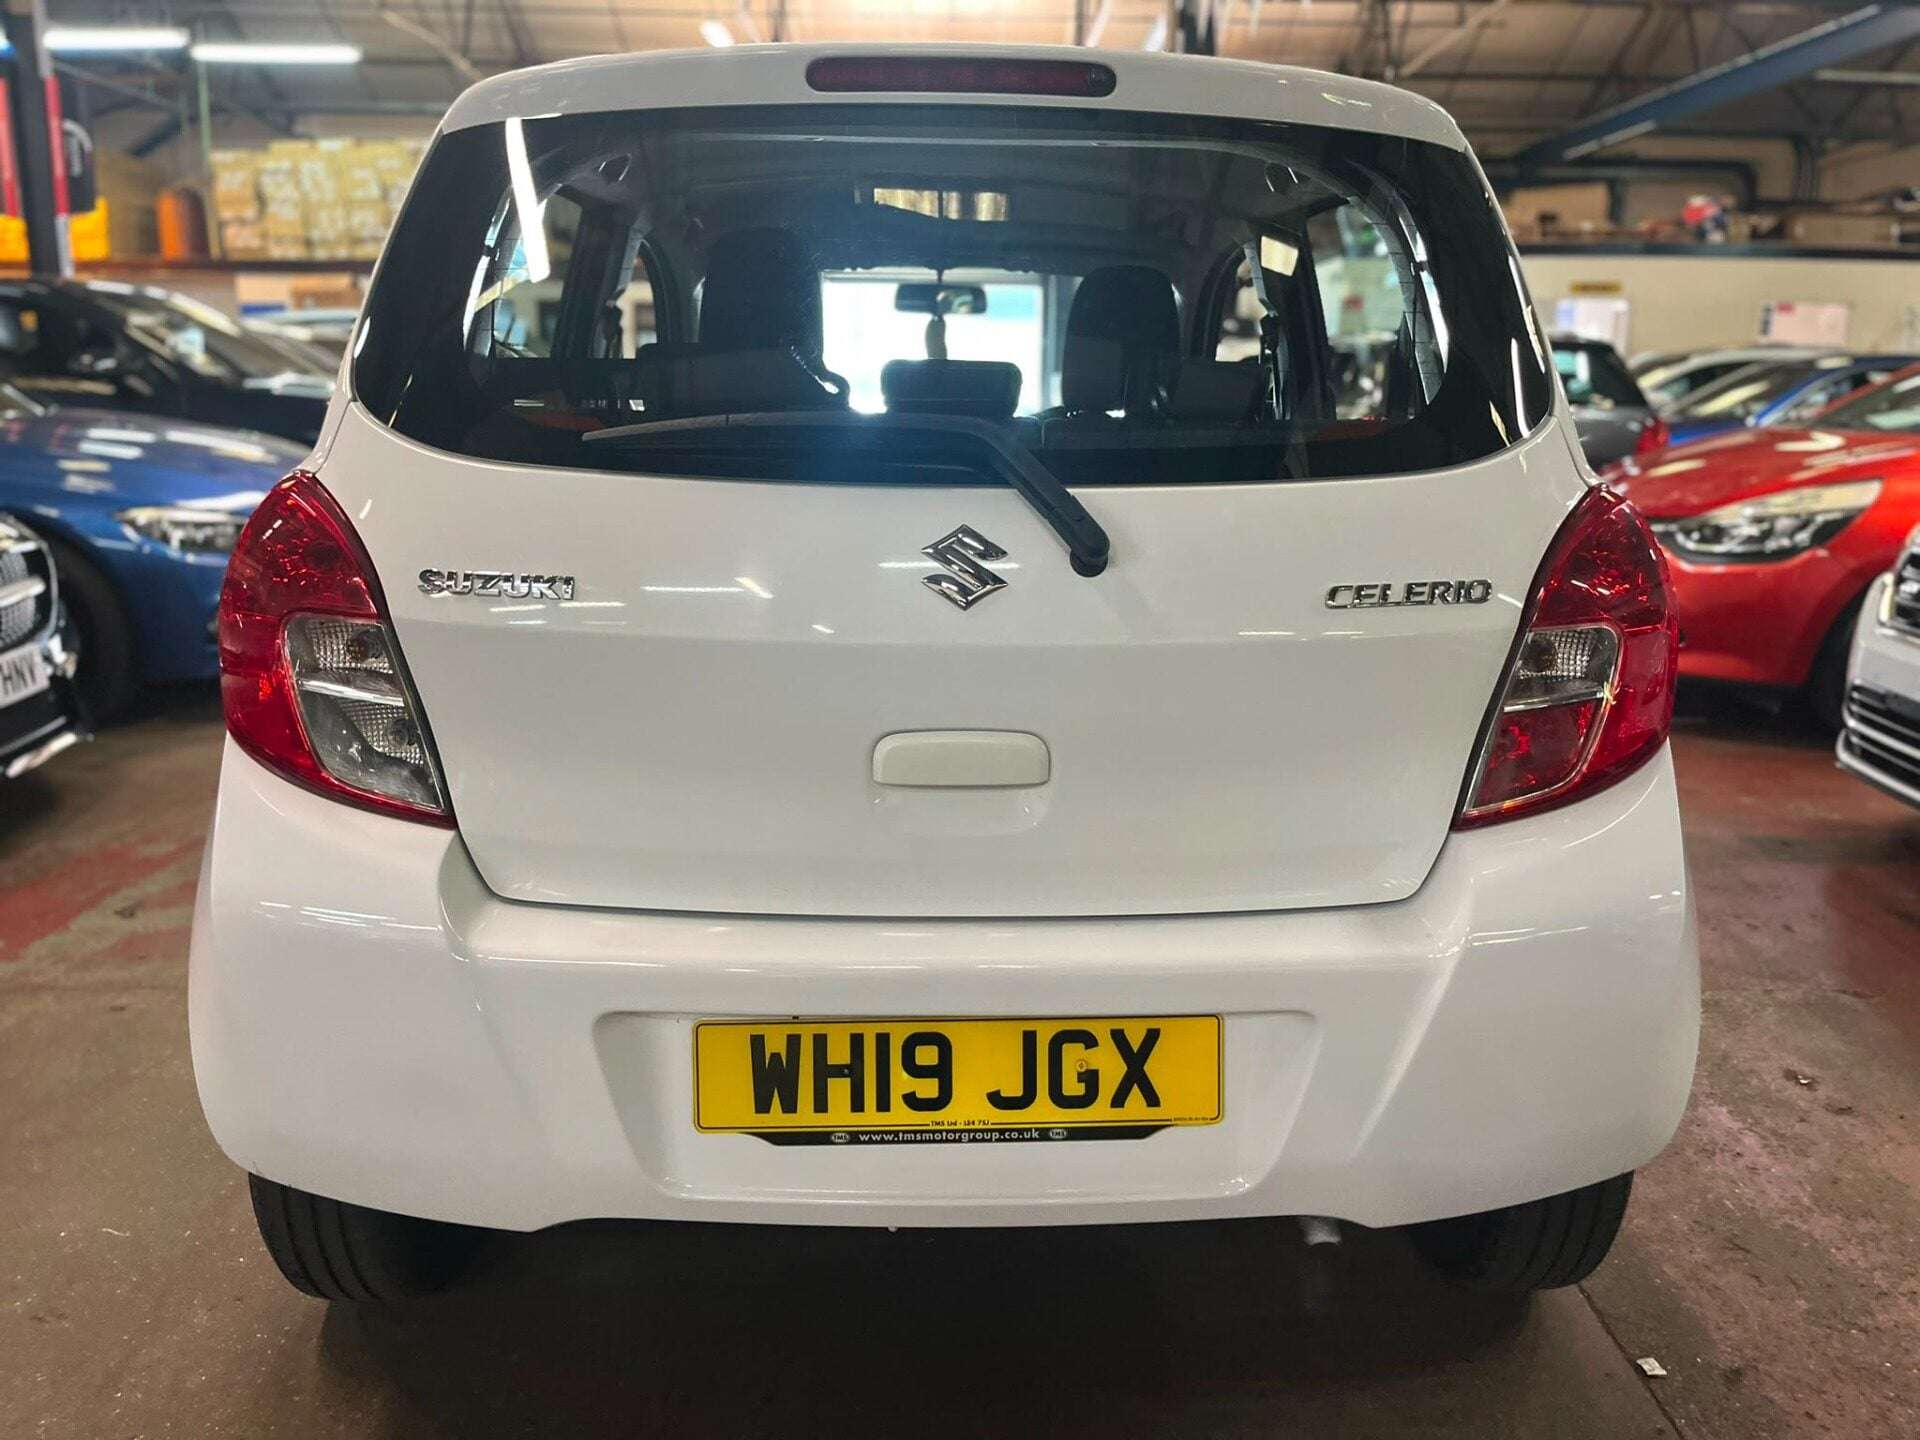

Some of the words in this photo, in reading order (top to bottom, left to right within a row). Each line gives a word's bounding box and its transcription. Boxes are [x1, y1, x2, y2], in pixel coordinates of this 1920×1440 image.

[417, 568, 575, 601] SUZUKI
[1325, 579, 1493, 609] CELERIO
[749, 1030, 954, 1114] WH19
[986, 1028, 1161, 1110] JGX
[859, 1128, 1040, 1142] www.tmsmotorgroup.co.uk
